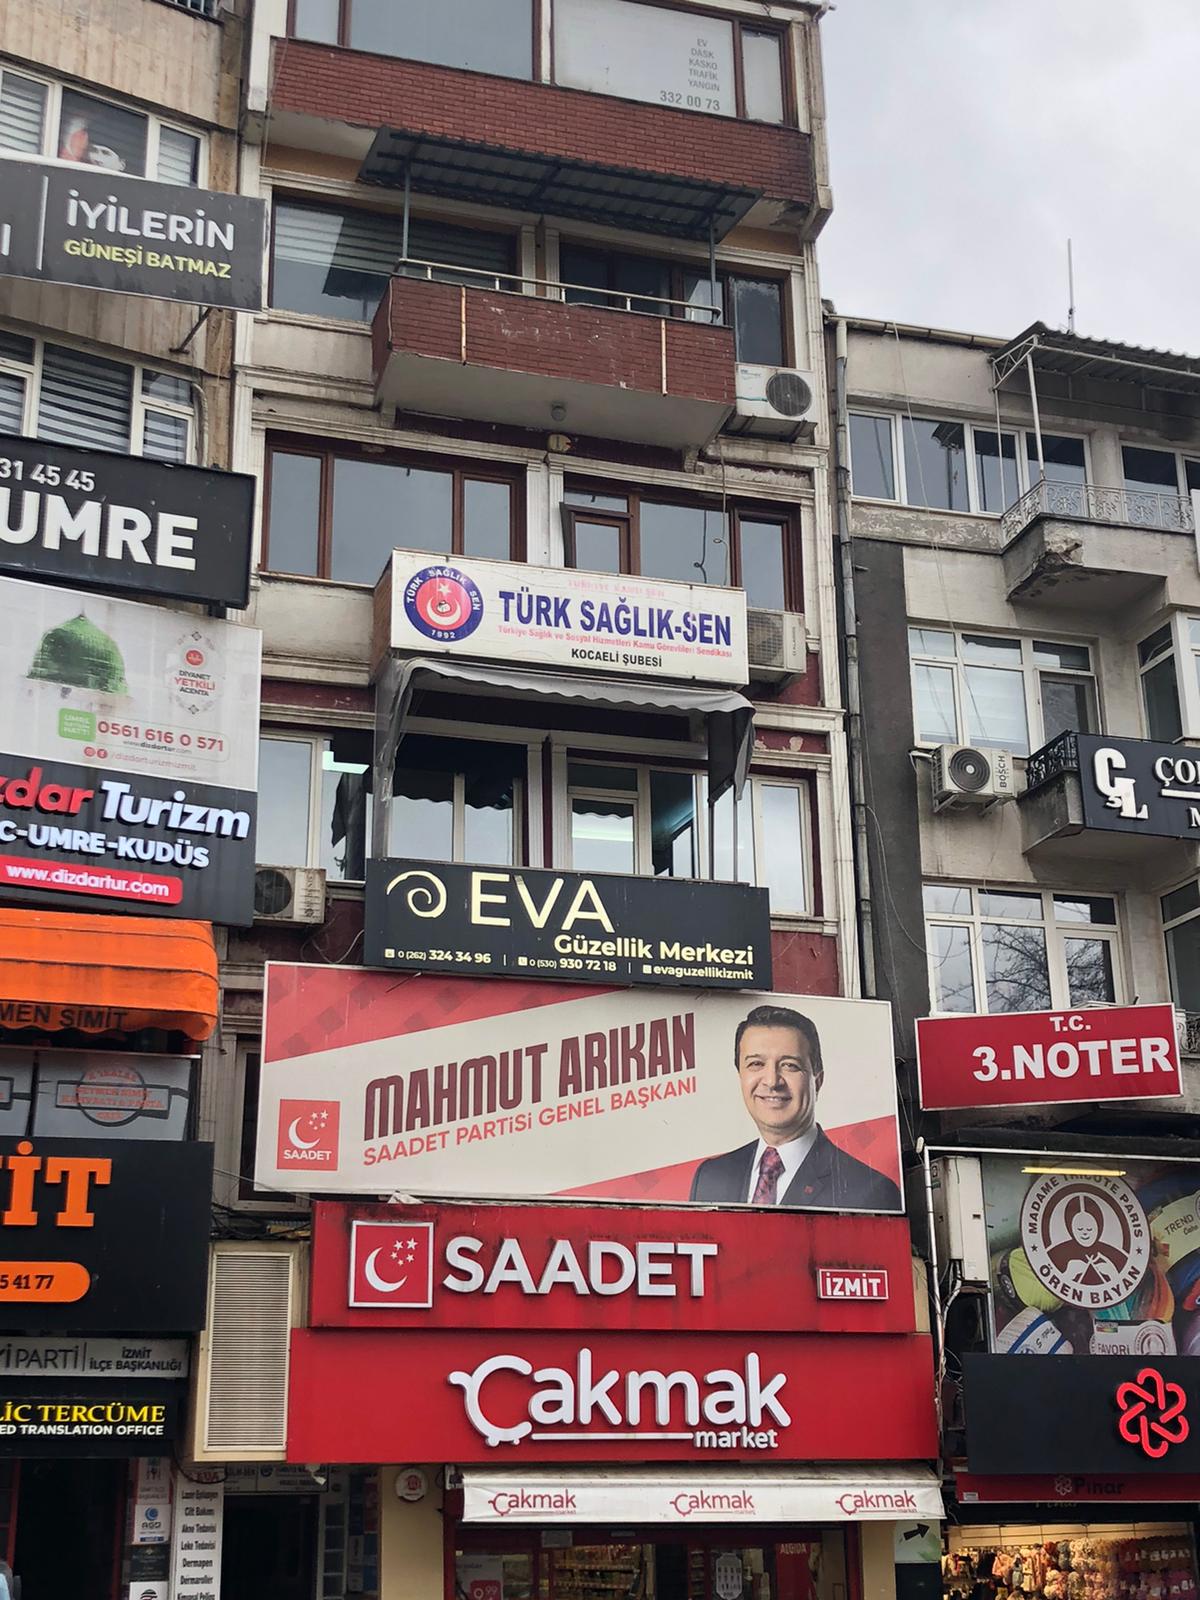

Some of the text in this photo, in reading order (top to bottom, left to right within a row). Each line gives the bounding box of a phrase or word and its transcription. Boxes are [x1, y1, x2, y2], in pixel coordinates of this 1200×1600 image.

[697, 38, 707, 47] EV
[689, 58, 717, 70] KASKO
[688, 79, 720, 91] YANGIN
[660, 90, 720, 111] 332 00 73
[66, 189, 235, 252] İYİLERİN
[63, 238, 232, 279] GÜNEŞİ BATMAZ
[30, 464, 61, 486] 45
[65, 469, 96, 492] 45
[0, 487, 198, 571] UMRE
[406, 569, 481, 611] TÜRK SAĞLIK SEN
[499, 586, 732, 646] TÜRK SAĞLIK-SEN
[431, 630, 456, 639] 1992
[498, 626, 527, 638] Türkiye
[565, 632, 591, 644] Sosyal
[592, 635, 631, 647] Hizmetleri
[633, 639, 655, 650] Kamu
[571, 648, 662, 667] KOCAELİ ŞUBESİ
[174, 676, 216, 691] YETKİLİ
[97, 720, 140, 739] 0561
[145, 728, 174, 744] 616
[197, 736, 224, 752] 571
[999, 755, 1007, 788] BOSCH
[101, 780, 250, 838] Turizm
[6, 865, 169, 896] www.dizdartur.com
[471, 871, 615, 933] EVA
[398, 949, 491, 964] 0 (262) 324 34 96
[554, 934, 753, 965] Güzellik Merkezi
[529, 958, 617, 972] 0 (530) 930 72 18
[653, 964, 754, 980] evaguzellikizmit
[60, 1005, 129, 1028] SİMİT
[1050, 1015, 1091, 1033] T.C.
[972, 1037, 1174, 1082] 3.NOTER
[363, 1012, 695, 1141] MAHMUT ARIKAN
[363, 1075, 697, 1165] SAADET PARTİSİ GENEL BAŞKANI
[283, 1149, 332, 1161] SAADET
[1028, 1176, 1060, 1234] MADAME
[1119, 1193, 1144, 1238] PARIS
[1164, 1214, 1194, 1235] TREND
[443, 1236, 718, 1298] SAADET
[13, 1274, 31, 1290] 41
[34, 1274, 54, 1290] 77
[824, 1273, 882, 1297] İZMİT
[1039, 1263, 1141, 1304] ÖREN BAYAN
[16, 1345, 79, 1369] PARTİ
[122, 1346, 153, 1359] İZMİT
[89, 1357, 182, 1372] İLÇE BAŞKANLIĞI
[37, 1402, 166, 1423] TERCÜME
[20, 1424, 113, 1436] TRANSLATION
[116, 1424, 165, 1436] OFFICE
[695, 1426, 778, 1449] market
[182, 1558, 213, 1569] Dermapen
